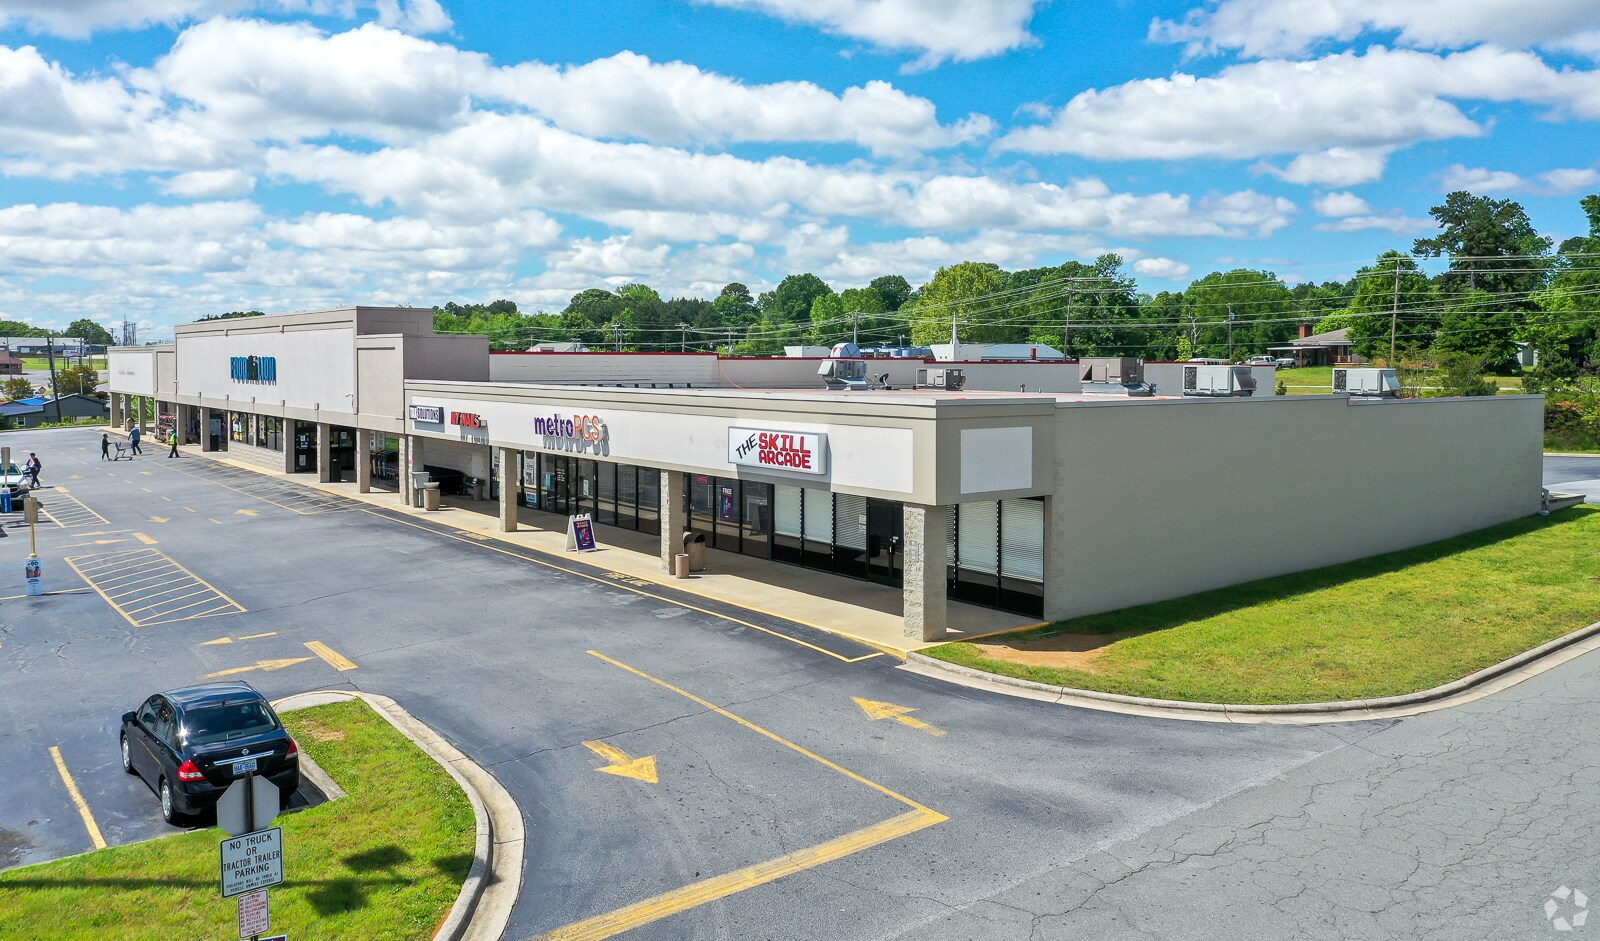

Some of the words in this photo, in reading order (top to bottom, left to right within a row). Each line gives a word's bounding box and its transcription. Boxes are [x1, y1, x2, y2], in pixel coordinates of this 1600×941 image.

[735, 433, 758, 459] THE
[758, 432, 811, 454] SKILL
[758, 450, 811, 469] ARCADE
[229, 841, 241, 851] NO
[246, 833, 272, 847] TRUCK
[246, 847, 257, 856] OR
[223, 858, 251, 872] TRACTOR
[255, 850, 280, 864] TRAILER
[235, 863, 270, 879] PARKING
